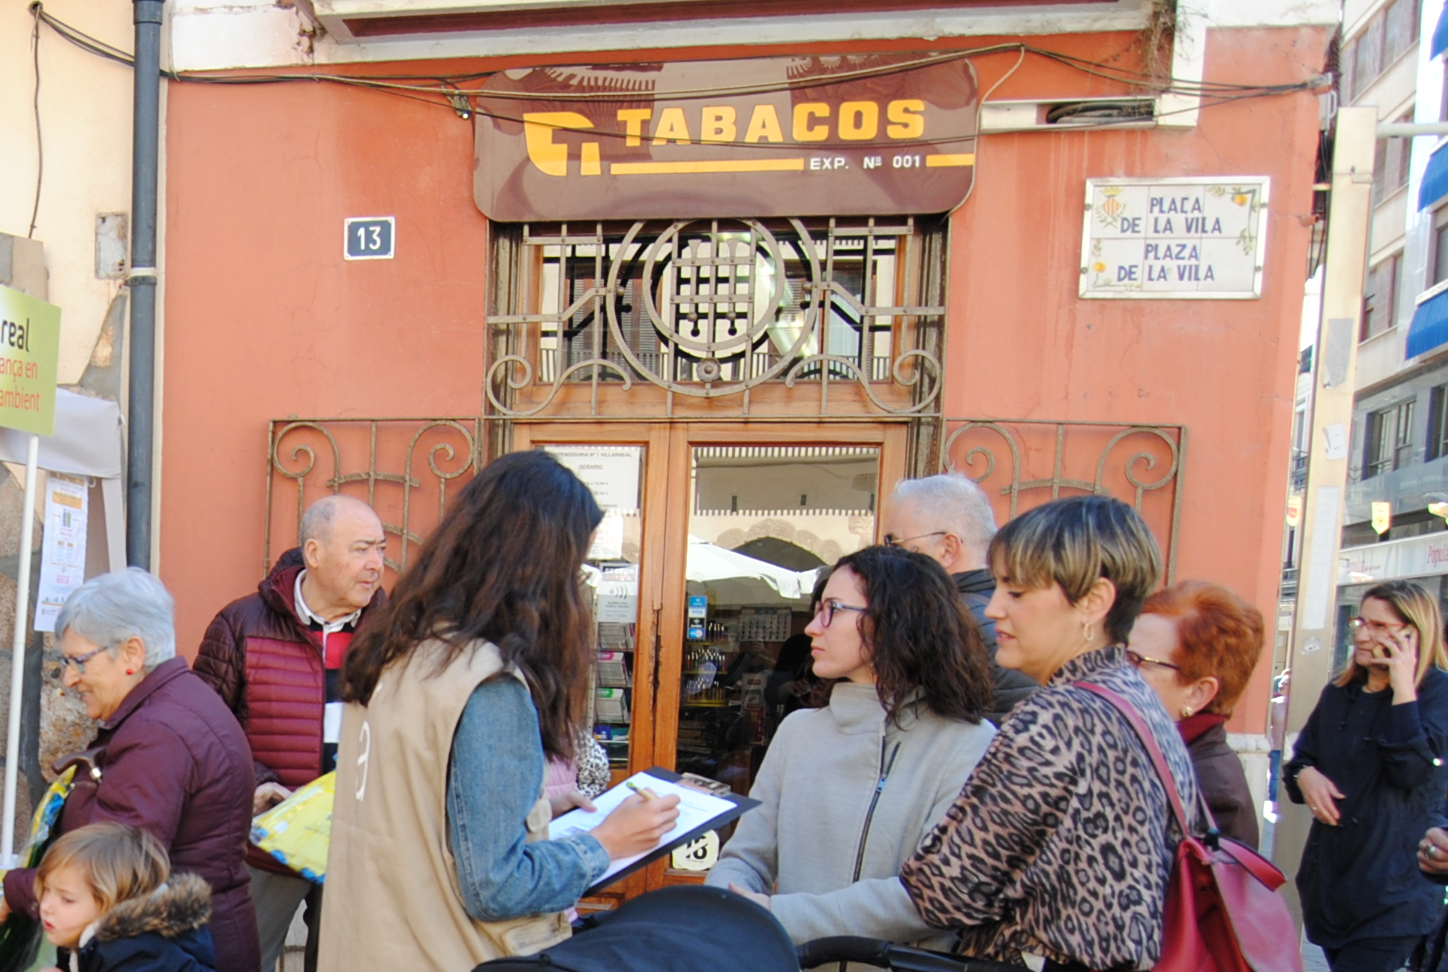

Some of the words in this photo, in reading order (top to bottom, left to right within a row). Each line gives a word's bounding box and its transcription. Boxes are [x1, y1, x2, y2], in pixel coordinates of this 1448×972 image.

[617, 99, 925, 147] TABACOS
[809, 157, 849, 170] EXP.
[892, 155, 920, 169] 001
[1120, 217, 1142, 234] DE
[1153, 217, 1174, 234] LA
[1185, 217, 1222, 234] VILA
[357, 226, 381, 250] 13
[1144, 243, 1200, 261] PLAZA
[1117, 265, 1139, 282] DE
[1147, 265, 1168, 282] LA
[1177, 264, 1215, 281] VILA
[26, 362, 38, 379] en
